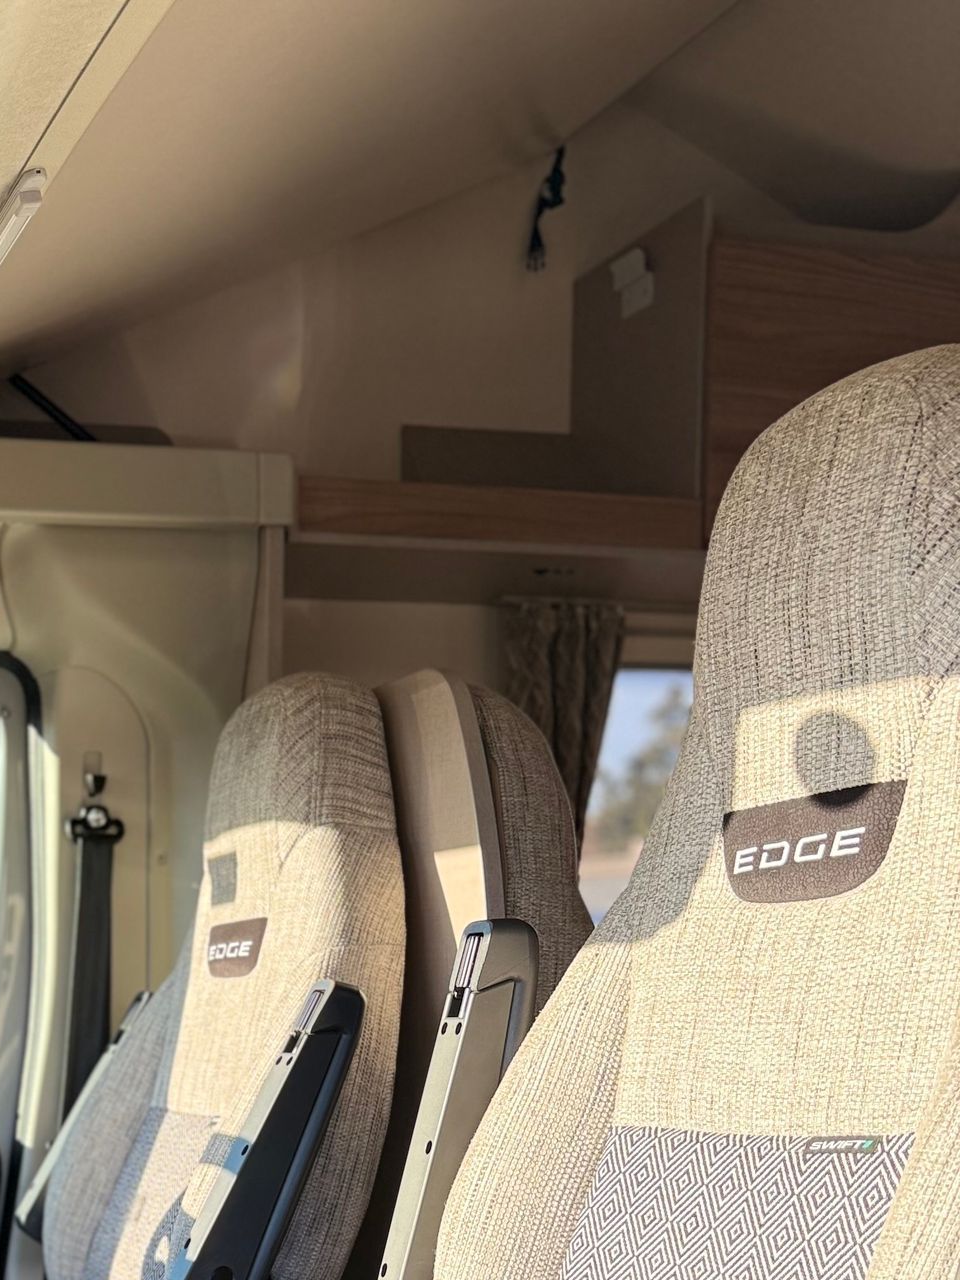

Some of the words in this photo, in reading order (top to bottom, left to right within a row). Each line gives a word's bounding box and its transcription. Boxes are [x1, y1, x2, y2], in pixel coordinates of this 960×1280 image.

[733, 826, 866, 875] EDGE
[209, 941, 253, 962] EDGE
[809, 1139, 866, 1150] SWIFT
